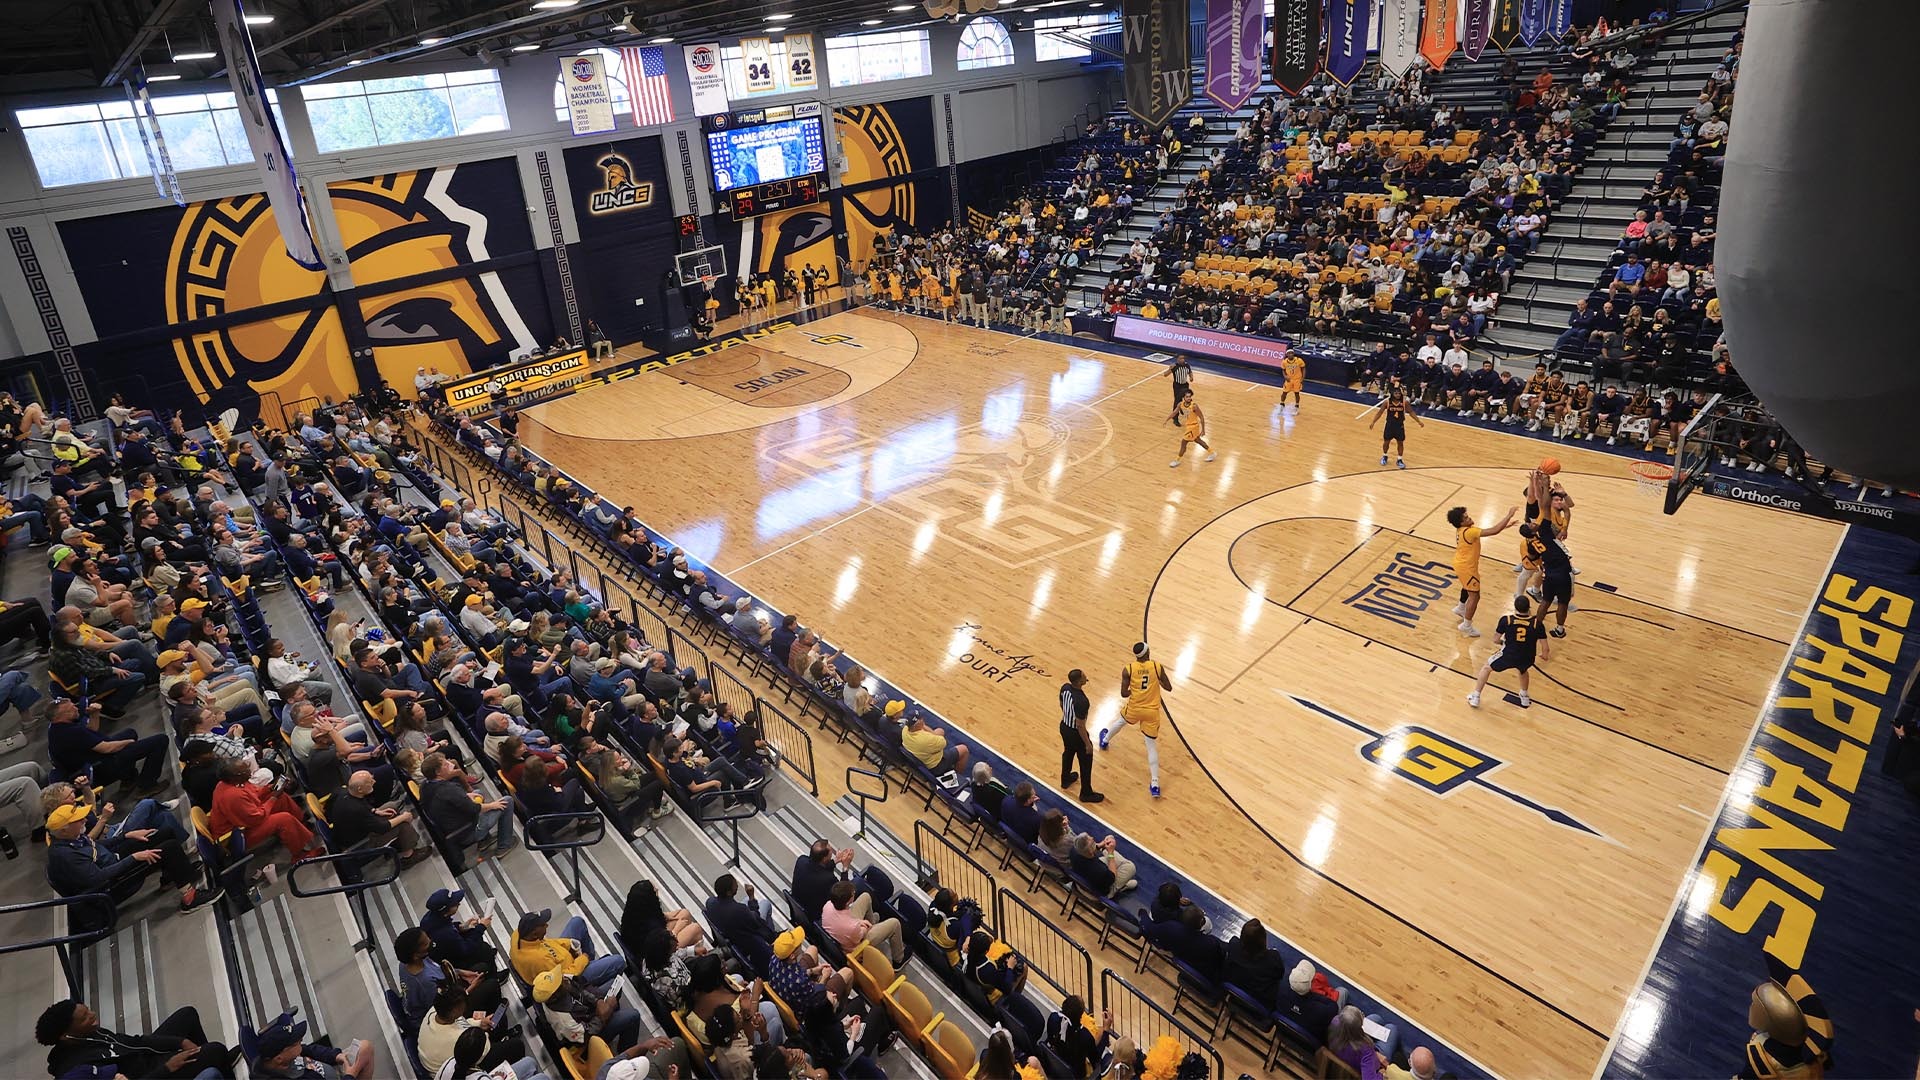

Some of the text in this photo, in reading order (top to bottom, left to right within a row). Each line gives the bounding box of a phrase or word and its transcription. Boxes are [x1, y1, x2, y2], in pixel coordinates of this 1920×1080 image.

[1285, 0, 1294, 66] VIRGIN
[1291, 0, 1302, 66] MILITA
[1230, 0, 1243, 96] CATAMOUNTS
[572, 62, 594, 77] SOCON
[748, 63, 770, 80] 34
[791, 58, 812, 75] 42
[571, 90, 606, 100] BASKETBALL
[572, 83, 602, 92] WOMEN'S
[571, 97, 608, 107] CHAMPIONS
[731, 132, 757, 144] GAME
[758, 126, 801, 140] PROGRAM
[593, 185, 652, 212] UNCG
[802, 187, 816, 200] 34
[738, 199, 753, 214] 29
[681, 222, 695, 236] 24
[1148, 328, 1173, 340] PROUD
[1173, 332, 1208, 347] PARTNER
[1208, 340, 1219, 348] OF
[1219, 341, 1241, 353] UNCG
[1241, 346, 1285, 360] ATHLETICS
[573, 321, 797, 391] SPARTANS
[733, 366, 811, 394] SOCON
[1730, 486, 1802, 511] OrthoCare
[1834, 499, 1895, 520] SPALDING
[1515, 627, 1527, 642] 2
[957, 653, 1013, 683] OURT
[1141, 675, 1149, 690] 2
[1703, 572, 1915, 970] SPARTANS
